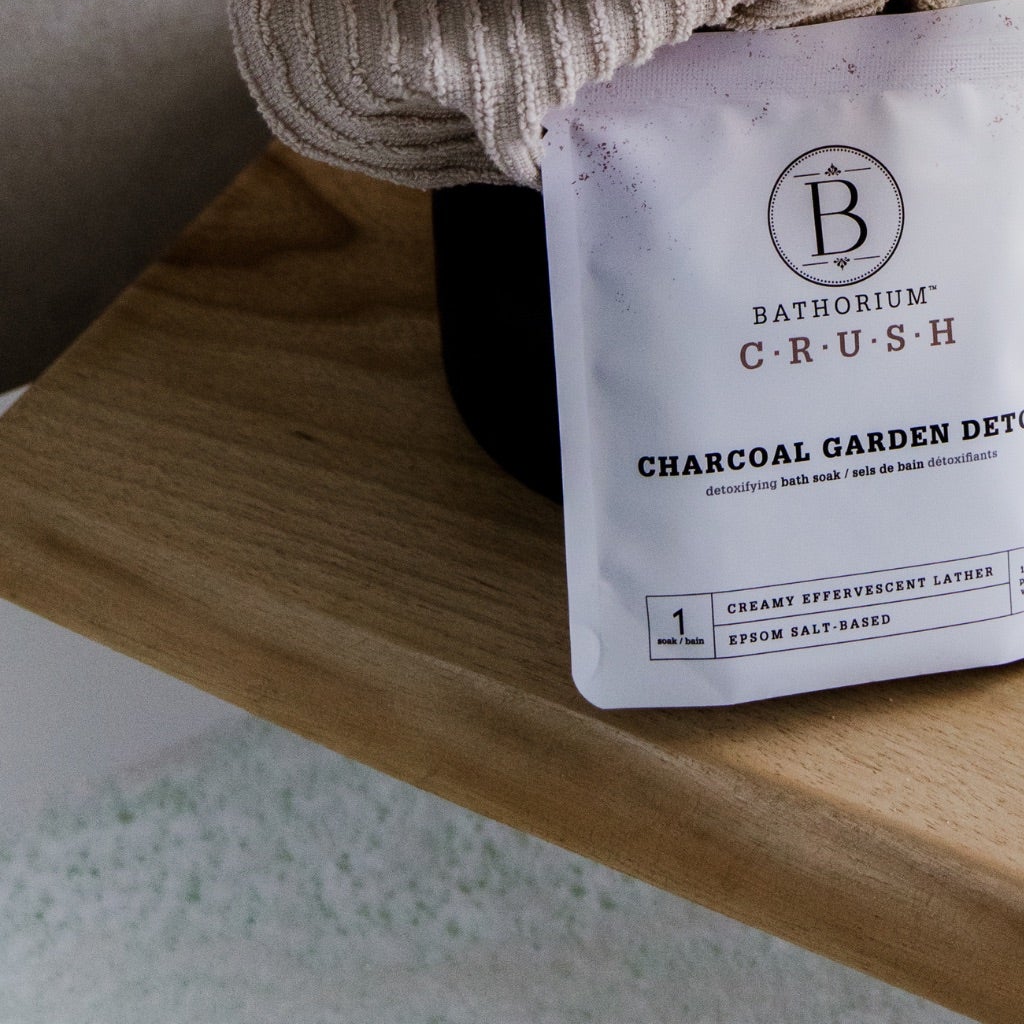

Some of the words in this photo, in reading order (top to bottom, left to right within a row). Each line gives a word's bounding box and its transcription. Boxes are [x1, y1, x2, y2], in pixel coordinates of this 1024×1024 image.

[804, 179, 868, 257] B
[637, 441, 811, 477] CHARCOAL
[822, 423, 950, 458] GARDEN
[706, 480, 777, 496] detoxifying
[781, 474, 810, 487] bath
[813, 470, 841, 483] soak
[852, 465, 876, 478] sels
[879, 463, 894, 474] de
[897, 459, 924, 472] bain
[927, 448, 998, 468] détoxifiants
[727, 595, 795, 614] CREAMY
[802, 577, 926, 604] EFFERVESCENT
[933, 566, 994, 586] LATHER
[657, 637, 677, 645] soak
[685, 636, 705, 645] bain
[673, 608, 685, 635] 1
[728, 629, 783, 646] EPSOM
[791, 614, 891, 638] SALT-BASED
